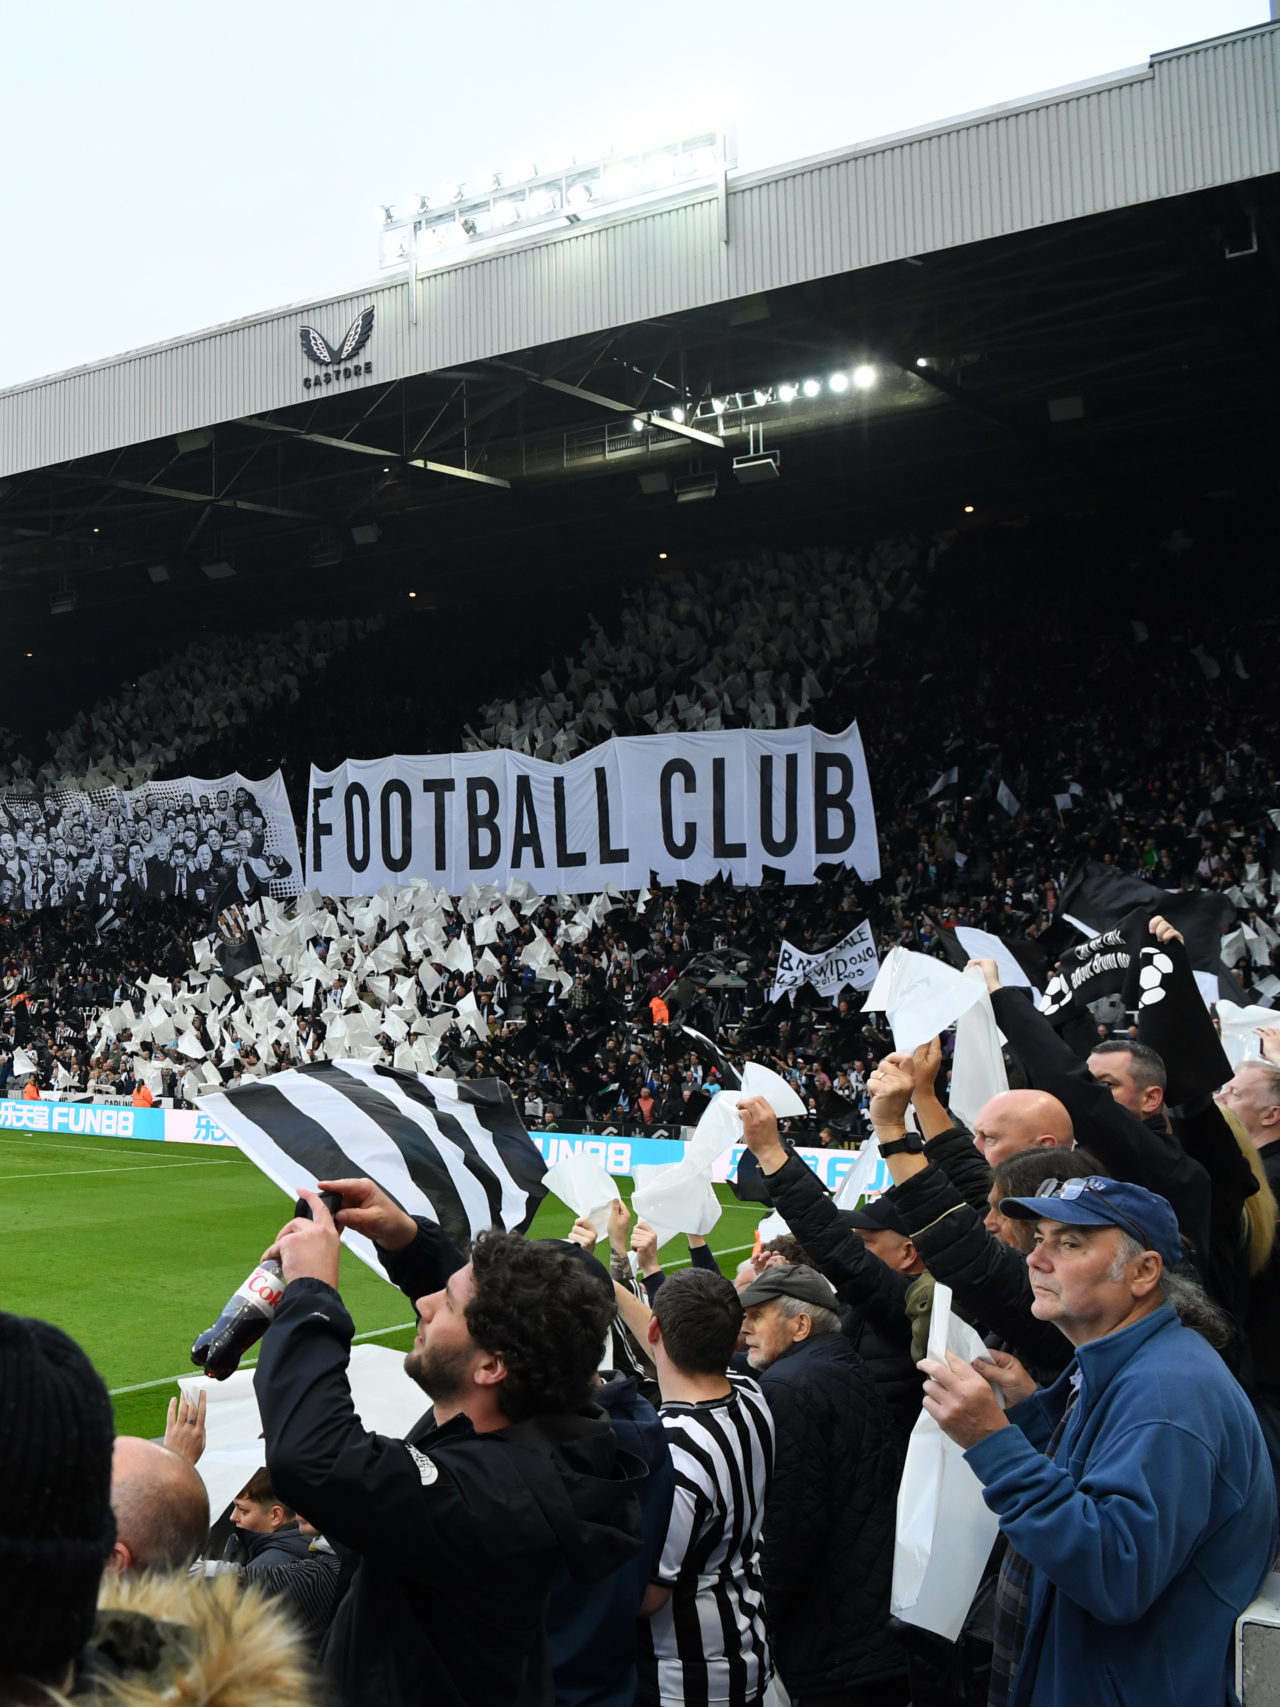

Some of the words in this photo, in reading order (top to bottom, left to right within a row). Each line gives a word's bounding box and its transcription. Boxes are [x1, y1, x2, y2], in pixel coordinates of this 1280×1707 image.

[303, 361, 372, 389] CASTORE
[312, 766, 629, 873] FOOTBALL
[659, 751, 855, 861] CLUB
[51, 1106, 134, 1137] FUN88
[532, 1137, 632, 1174] UN88
[248, 1275, 283, 1308] Cok
